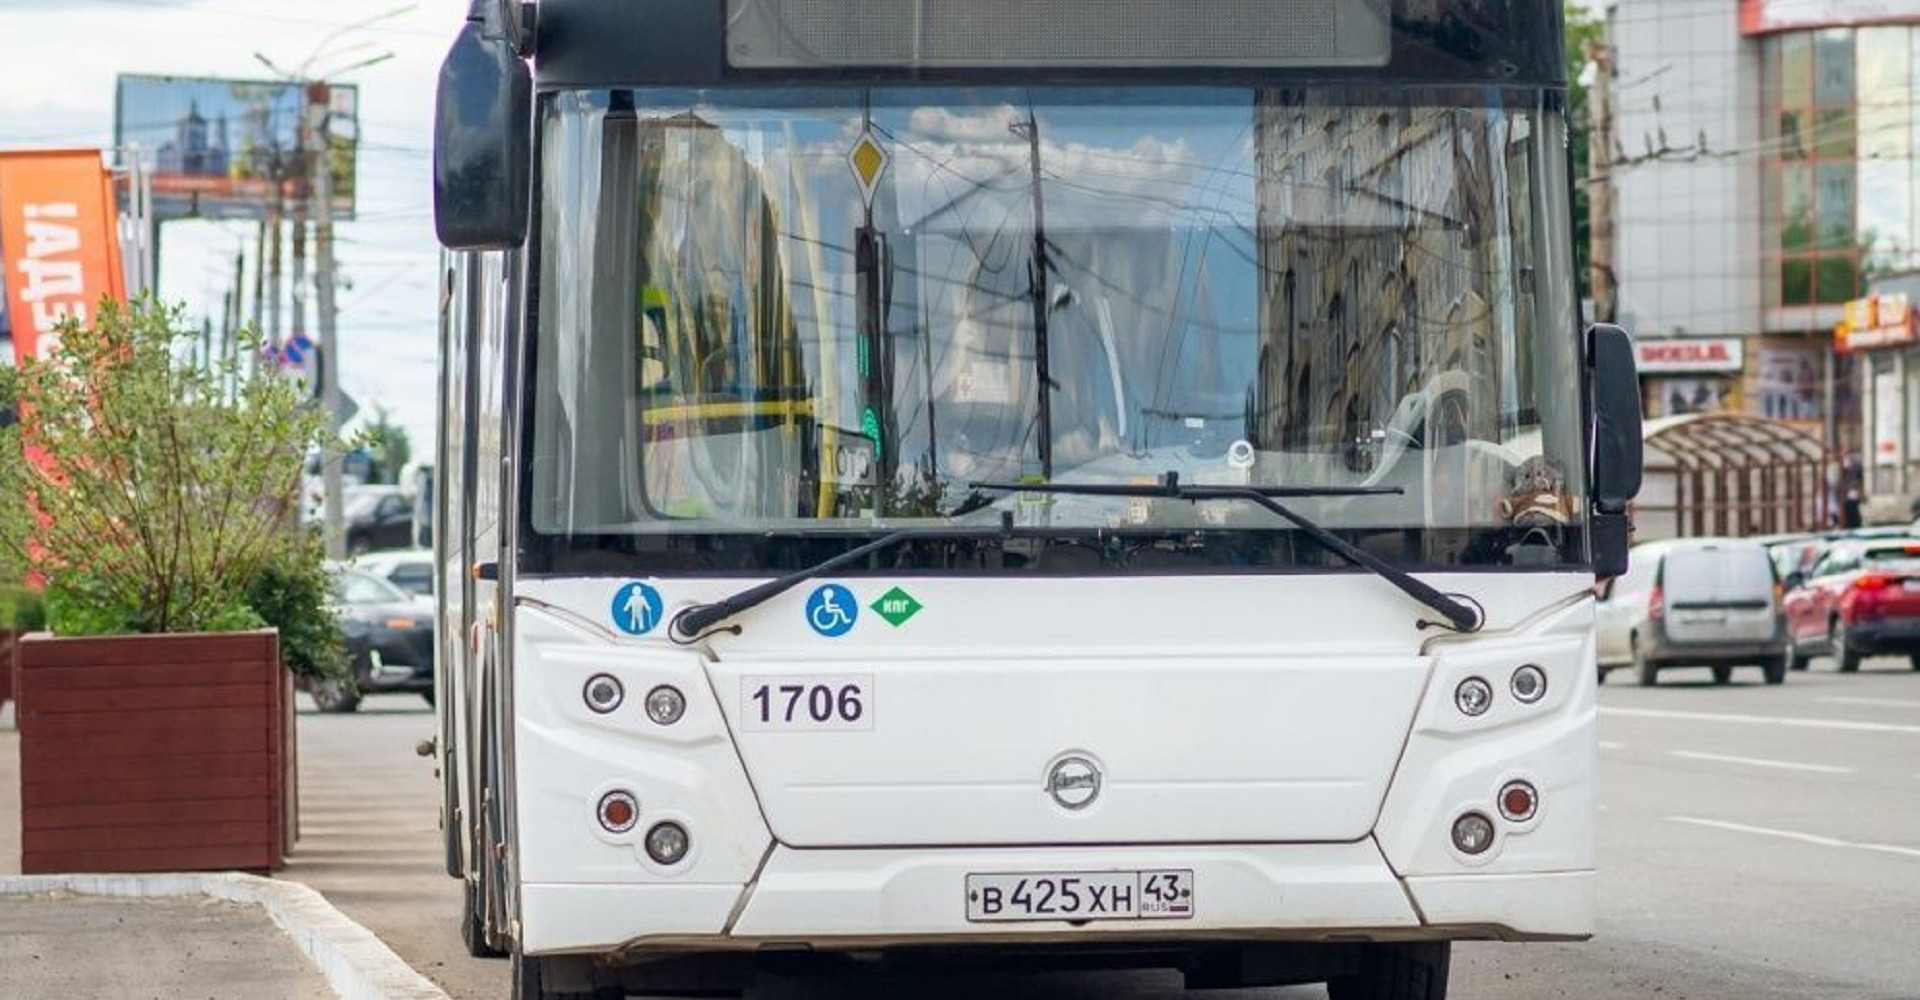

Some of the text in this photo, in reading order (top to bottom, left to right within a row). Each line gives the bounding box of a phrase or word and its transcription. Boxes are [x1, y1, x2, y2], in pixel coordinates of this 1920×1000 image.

[883, 599, 909, 614] КПГ
[753, 684, 862, 722] 1706
[1145, 875, 1178, 901] 43
[1142, 902, 1168, 911] RUS
